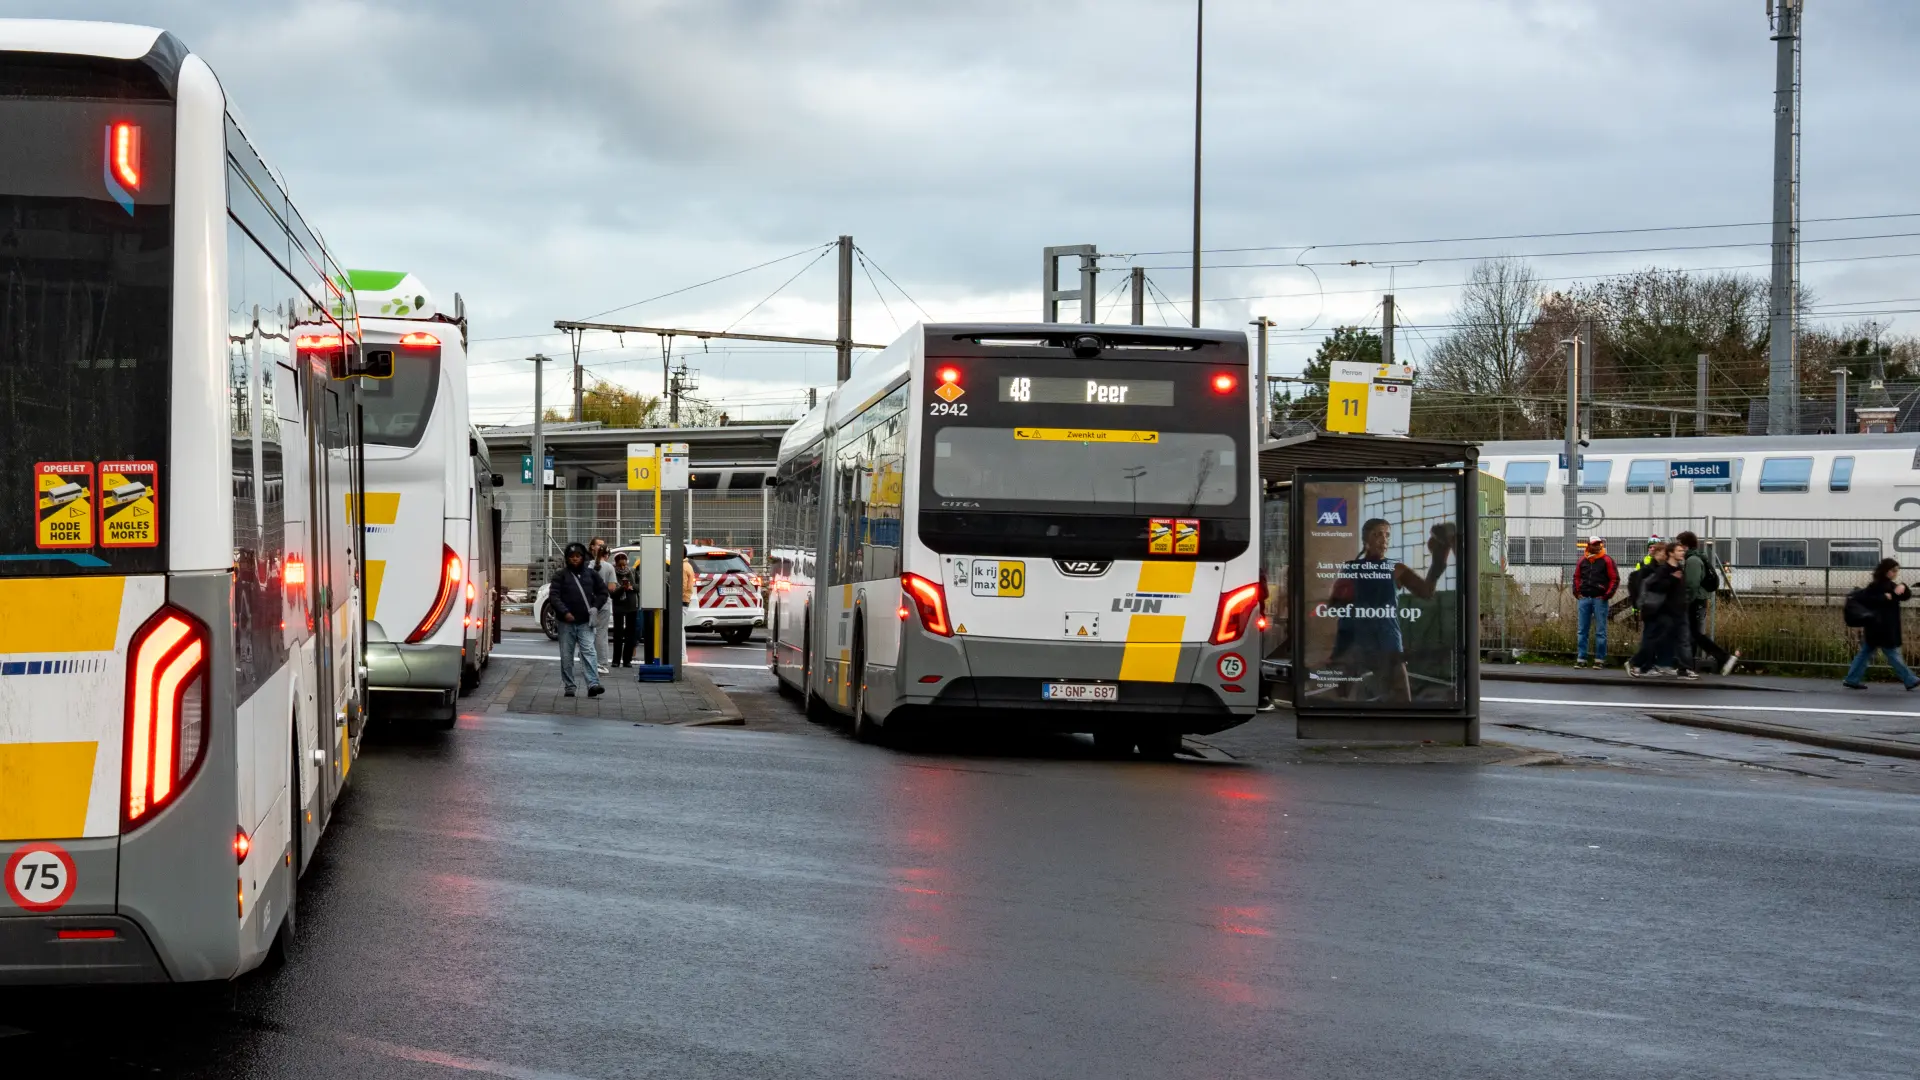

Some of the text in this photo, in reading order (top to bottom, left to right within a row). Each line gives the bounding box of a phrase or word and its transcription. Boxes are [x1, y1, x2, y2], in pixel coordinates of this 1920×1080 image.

[1009, 377, 1129, 403] 48 Peer
[929, 403, 968, 416] 2942
[1341, 398, 1359, 416] 11
[1067, 431, 1095, 439] Zwenkt
[43, 464, 85, 473] OPGELET
[102, 463, 154, 472] ATTENTION
[1680, 464, 1720, 475] Hasselt
[633, 467, 650, 480] 10
[1316, 512, 1342, 524] AXA
[50, 521, 81, 531] DODE
[108, 521, 150, 530] ANGLES
[50, 531, 81, 541] HOEK
[111, 530, 148, 539] MORTS
[974, 566, 997, 578] Ik rij
[1064, 562, 1100, 572] VDL
[1361, 562, 1378, 570] elke
[1380, 562, 1395, 571] dag
[999, 568, 1022, 590] 80
[1337, 571, 1358, 579] moet
[1359, 571, 1391, 579] vechten
[974, 581, 996, 589] max
[1111, 598, 1162, 613] LIJN
[1315, 603, 1421, 622] Geef nooit op
[1224, 659, 1240, 671] 75
[22, 864, 59, 890] 75
